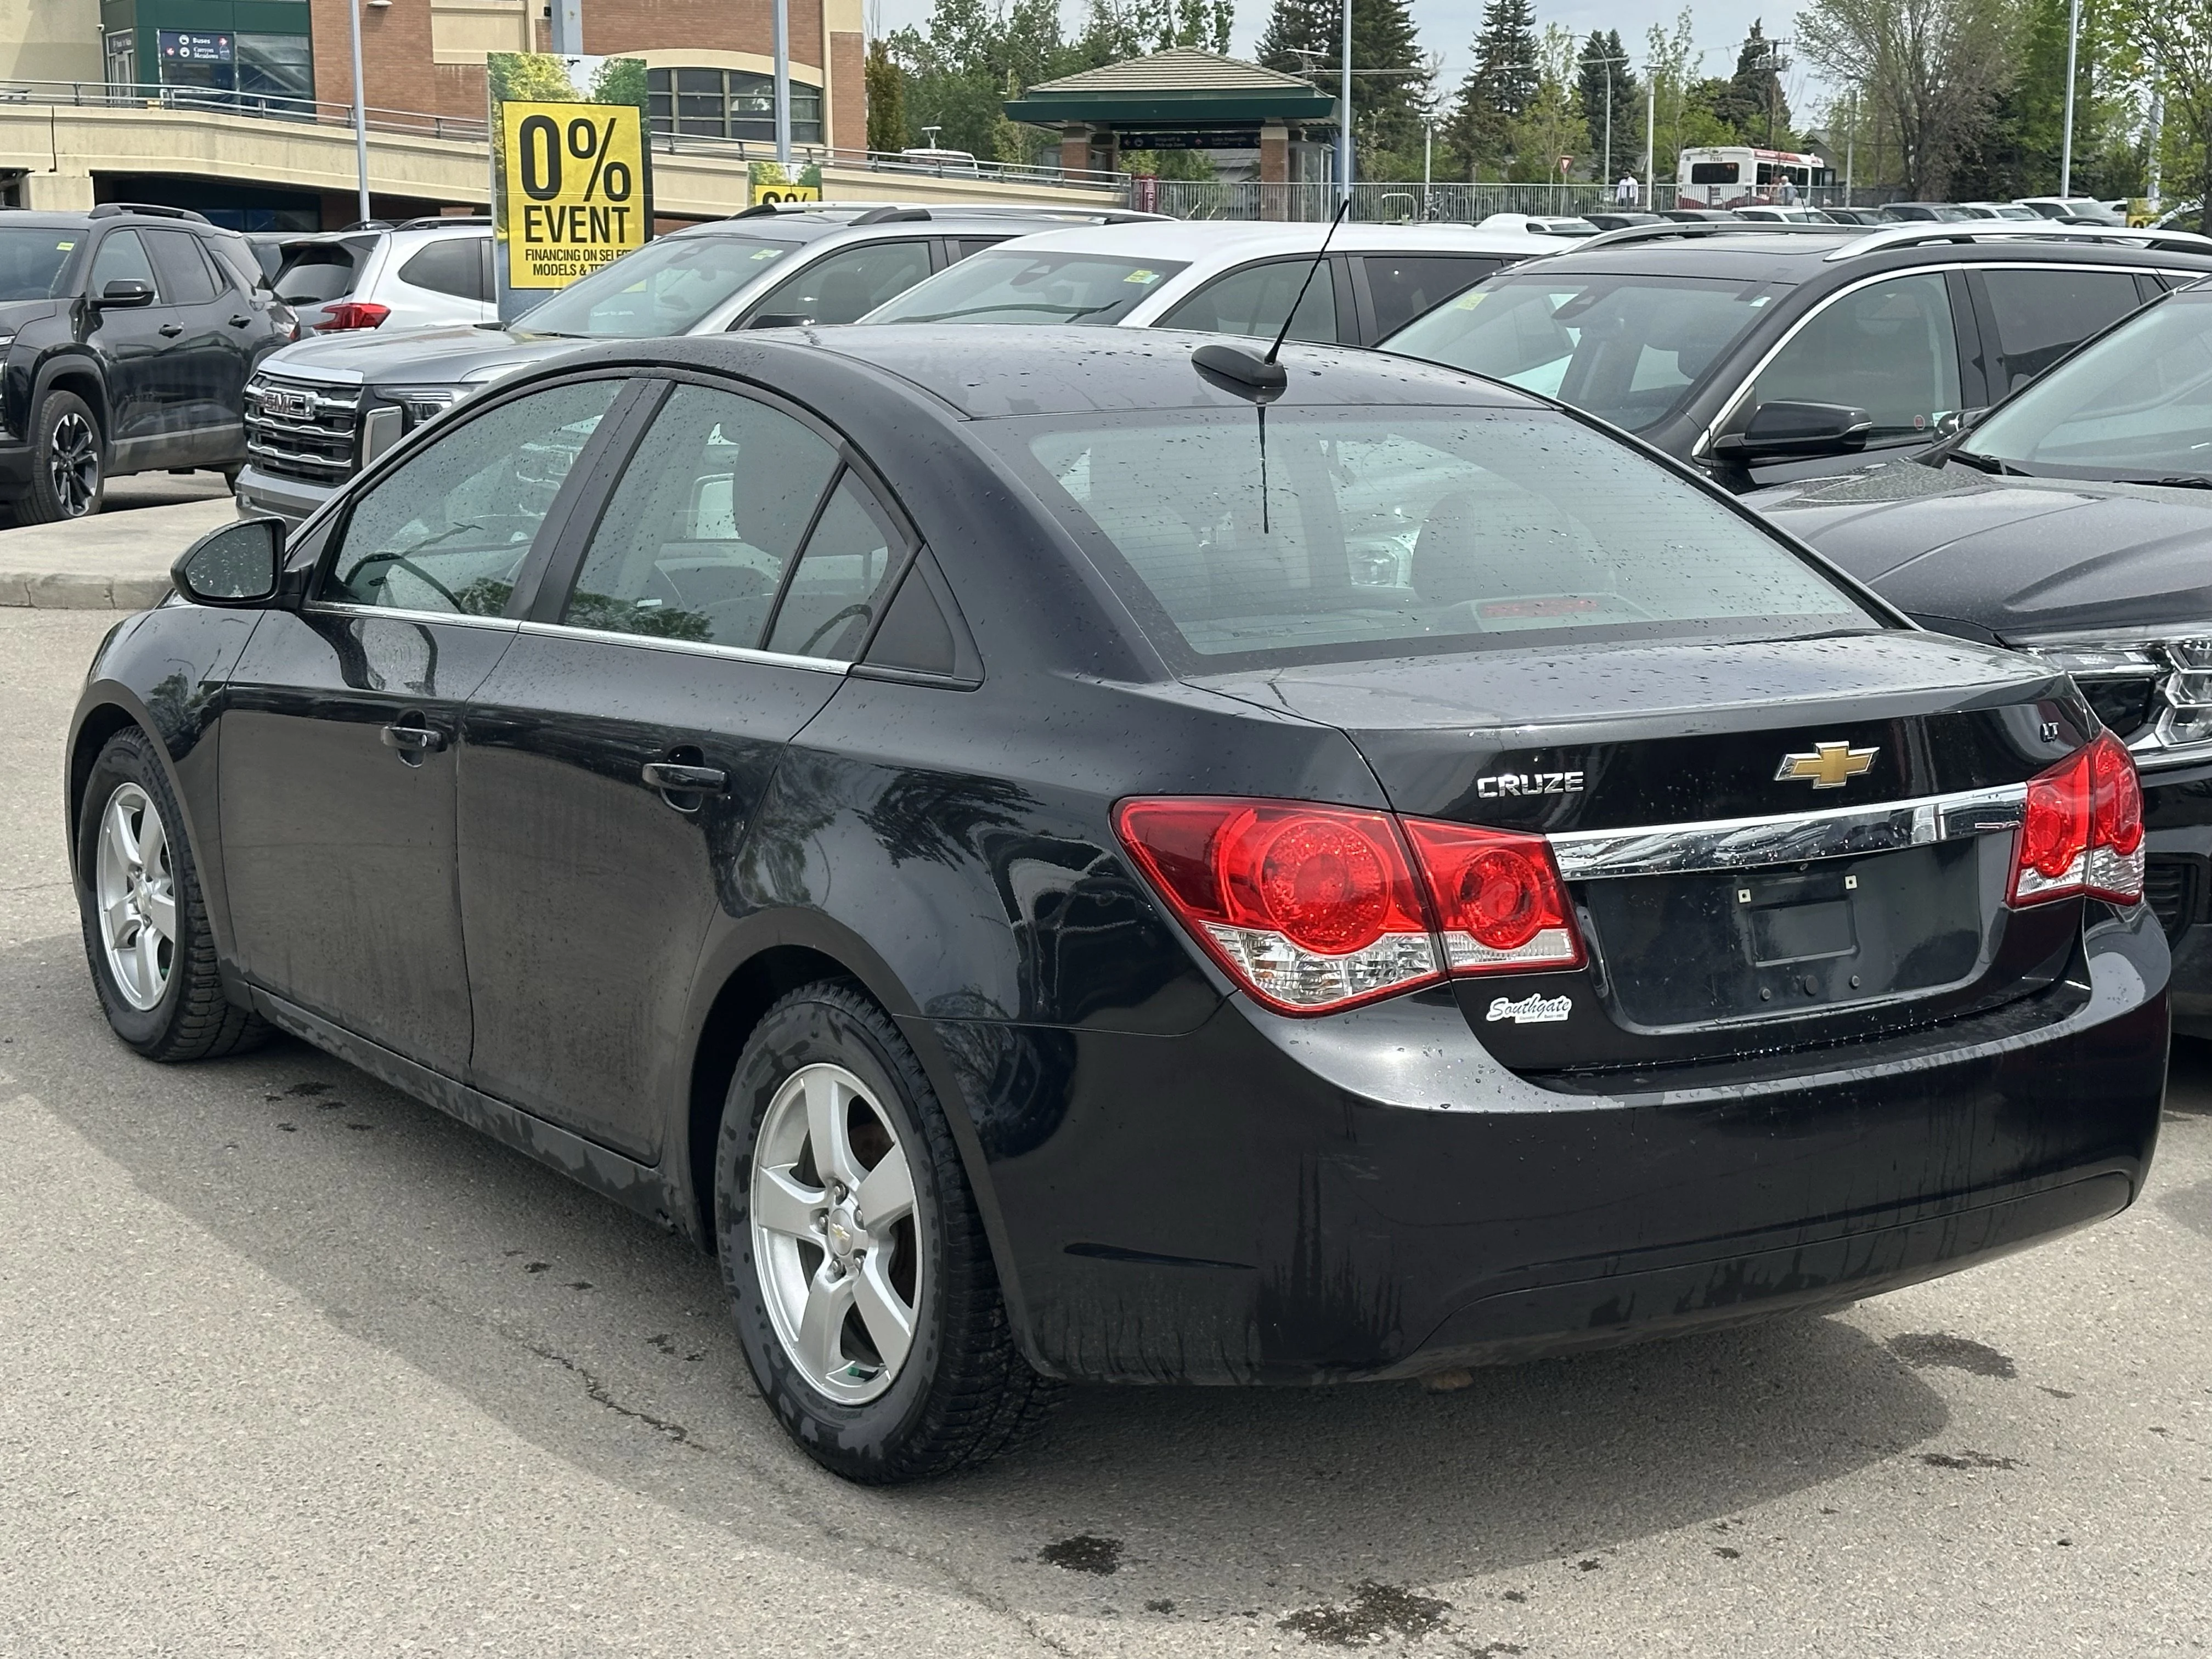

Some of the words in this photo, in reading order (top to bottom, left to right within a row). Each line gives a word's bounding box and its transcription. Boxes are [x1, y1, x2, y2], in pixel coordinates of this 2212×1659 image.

[520, 115, 631, 202] 0%
[524, 205, 630, 243] EVENT
[525, 249, 581, 261] FINANCING
[583, 249, 597, 261] ON
[599, 249, 633, 261] SELEC
[533, 263, 577, 276] MODELS
[579, 264, 587, 275] &
[264, 392, 306, 416] GMC
[2041, 721, 2059, 742] LT
[1477, 771, 1584, 798] CRUZE
[1489, 996, 1570, 1019] Southgate
